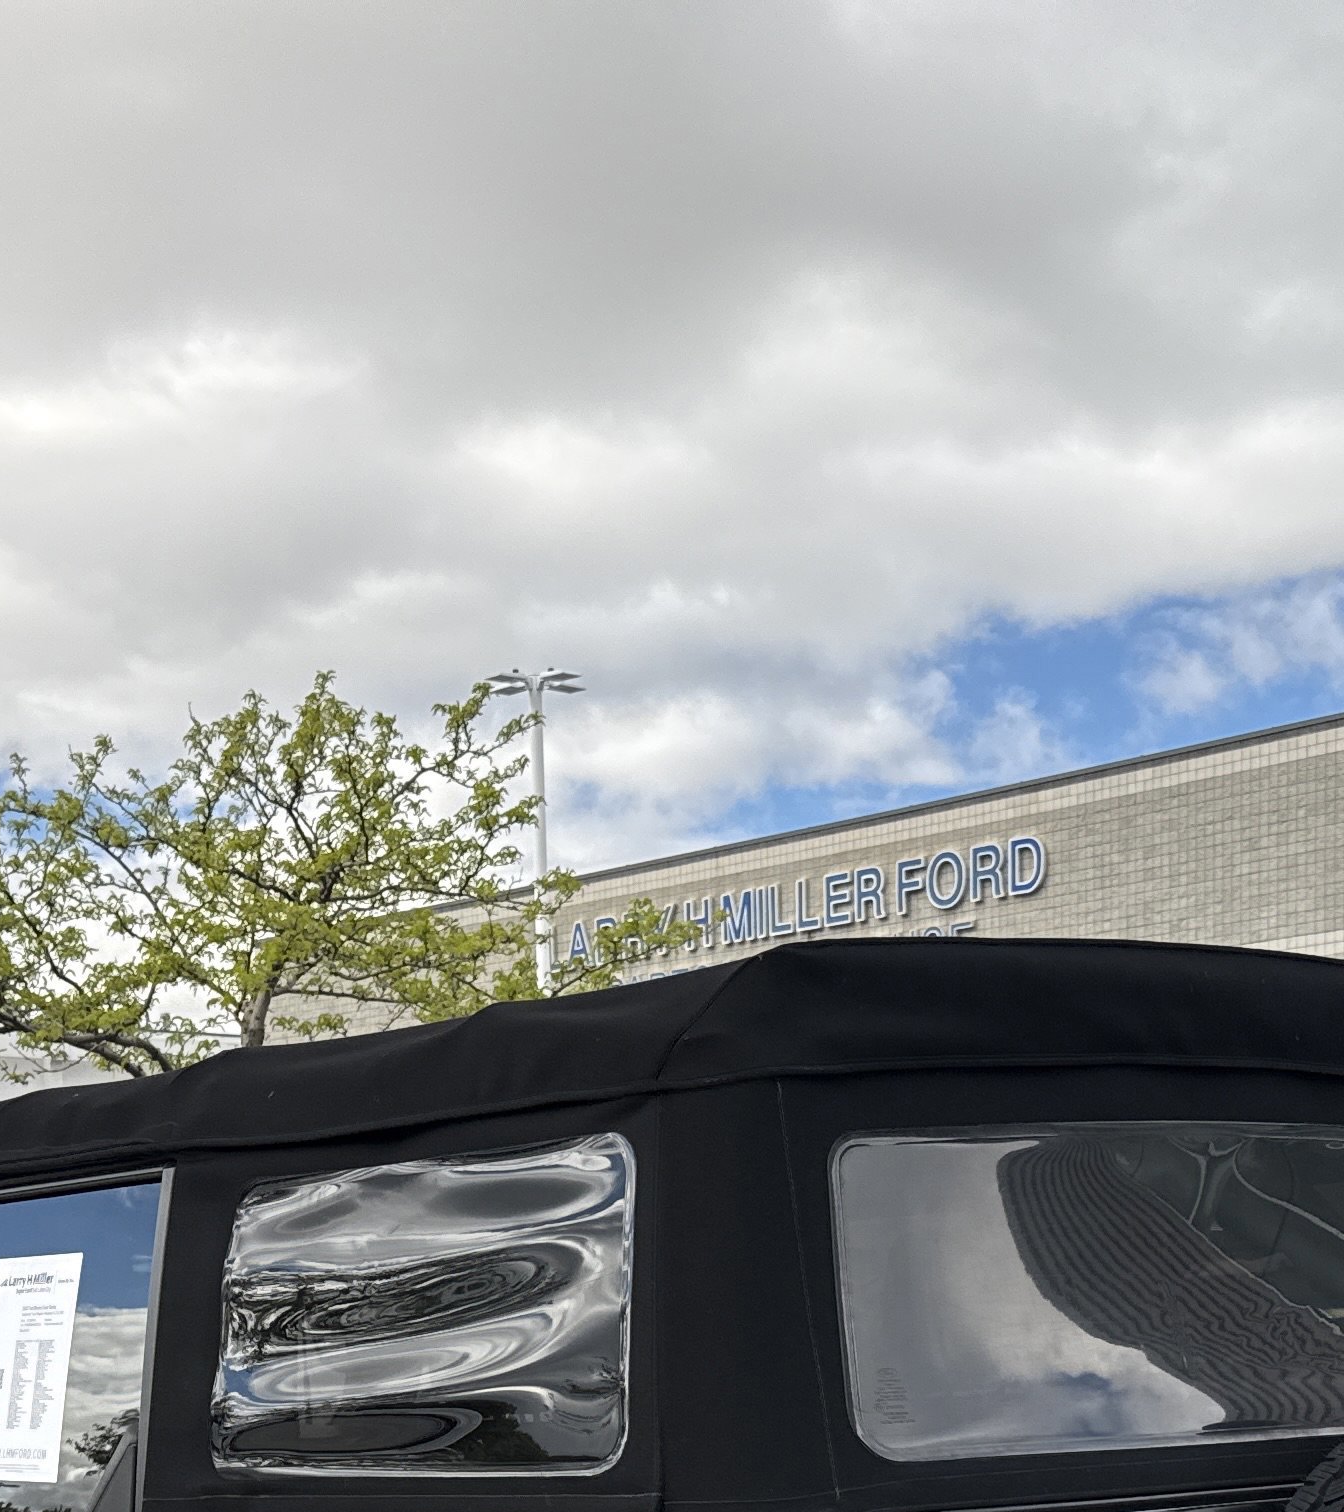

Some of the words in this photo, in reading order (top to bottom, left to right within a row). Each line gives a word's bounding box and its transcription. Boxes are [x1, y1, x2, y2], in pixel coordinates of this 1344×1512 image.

[682, 895, 714, 951] H
[720, 866, 887, 945] MILLER
[896, 836, 1046, 916] FORD
[8, 1275, 27, 1288] Larry
[27, 1274, 34, 1285] H
[33, 1272, 54, 1285] Miller
